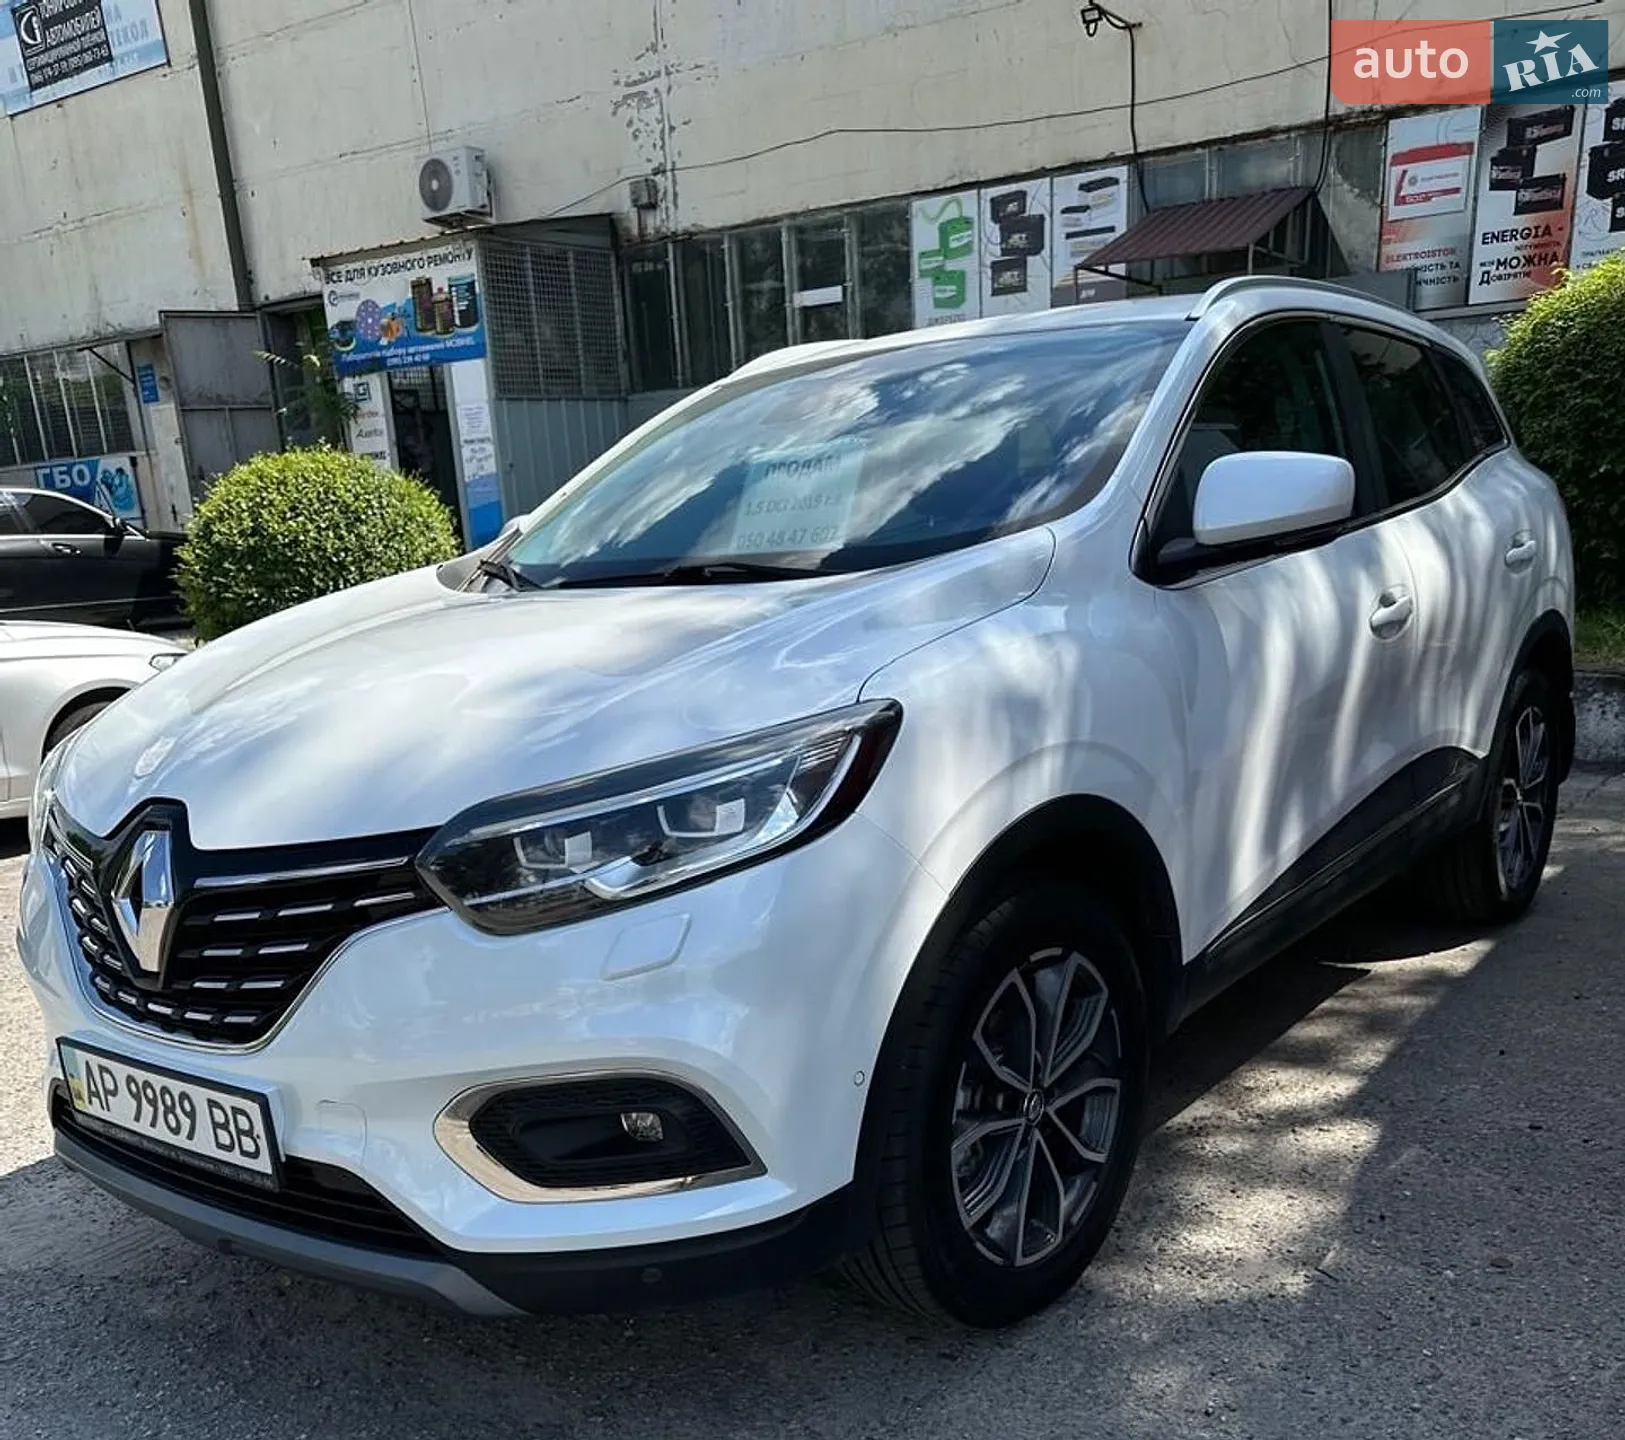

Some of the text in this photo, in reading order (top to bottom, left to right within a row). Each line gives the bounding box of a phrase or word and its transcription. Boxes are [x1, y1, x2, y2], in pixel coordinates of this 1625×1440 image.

[1481, 224, 1552, 245] ENERGIA
[344, 267, 366, 282] ДЛЯ
[367, 256, 425, 279] КУЗОВНОГО
[427, 247, 473, 268] РЕМОНТУ
[37, 463, 92, 489] ГБО
[85, 1060, 118, 1112] AP
[125, 1074, 197, 1141] 9989
[206, 1098, 261, 1160] BB
